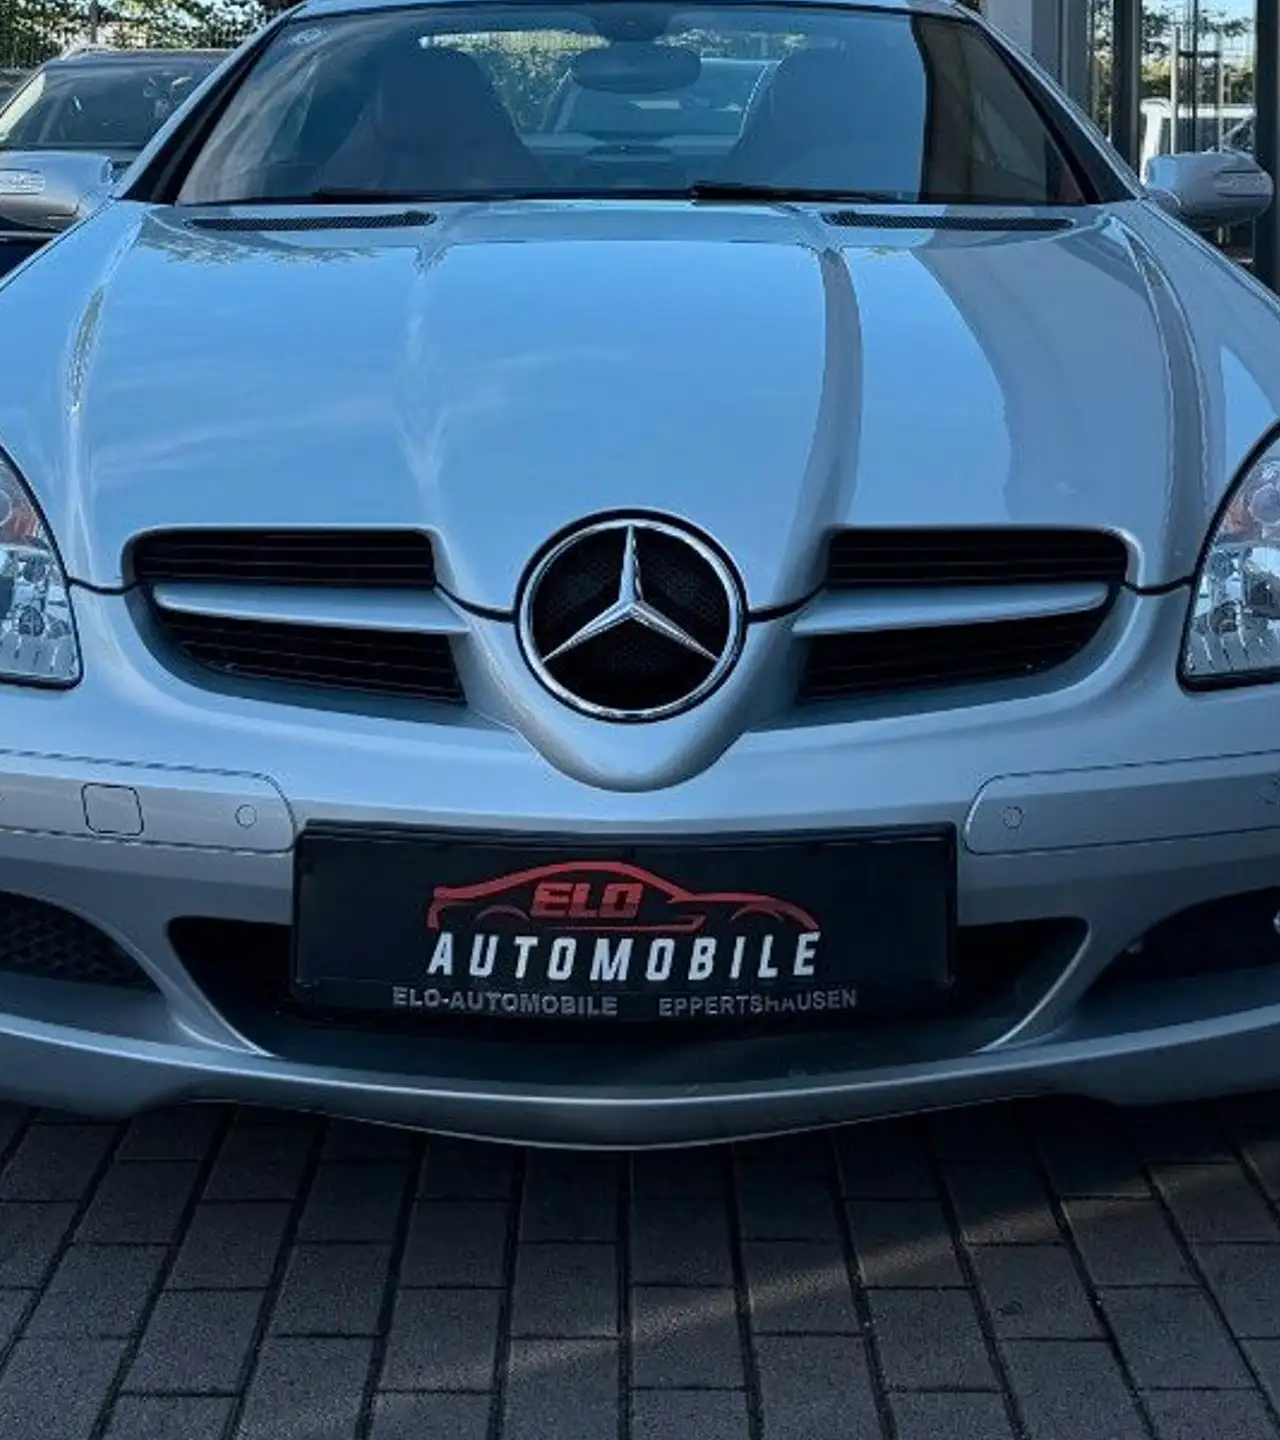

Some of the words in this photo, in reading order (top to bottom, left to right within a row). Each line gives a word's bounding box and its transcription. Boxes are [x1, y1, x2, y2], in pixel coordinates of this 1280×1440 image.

[530, 882, 644, 919] ELO
[426, 931, 821, 982] AUTOMOBILE
[392, 986, 618, 1017] ELO-AUTOMOBILE
